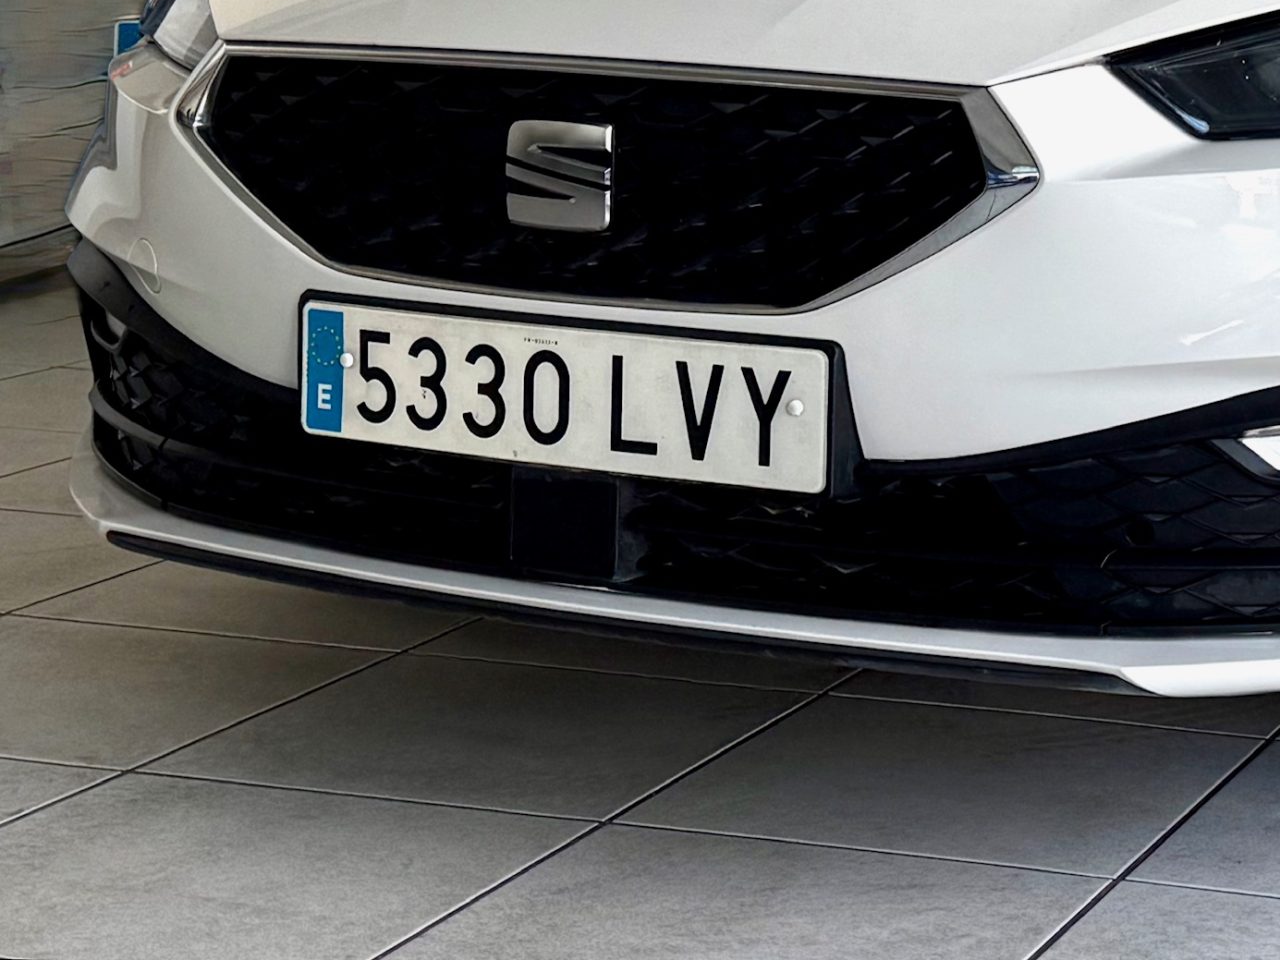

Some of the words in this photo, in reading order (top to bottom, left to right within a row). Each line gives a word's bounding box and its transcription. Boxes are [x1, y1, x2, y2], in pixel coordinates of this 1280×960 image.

[317, 383, 332, 410] E
[356, 328, 572, 446] 5330
[610, 354, 793, 468] LVY
